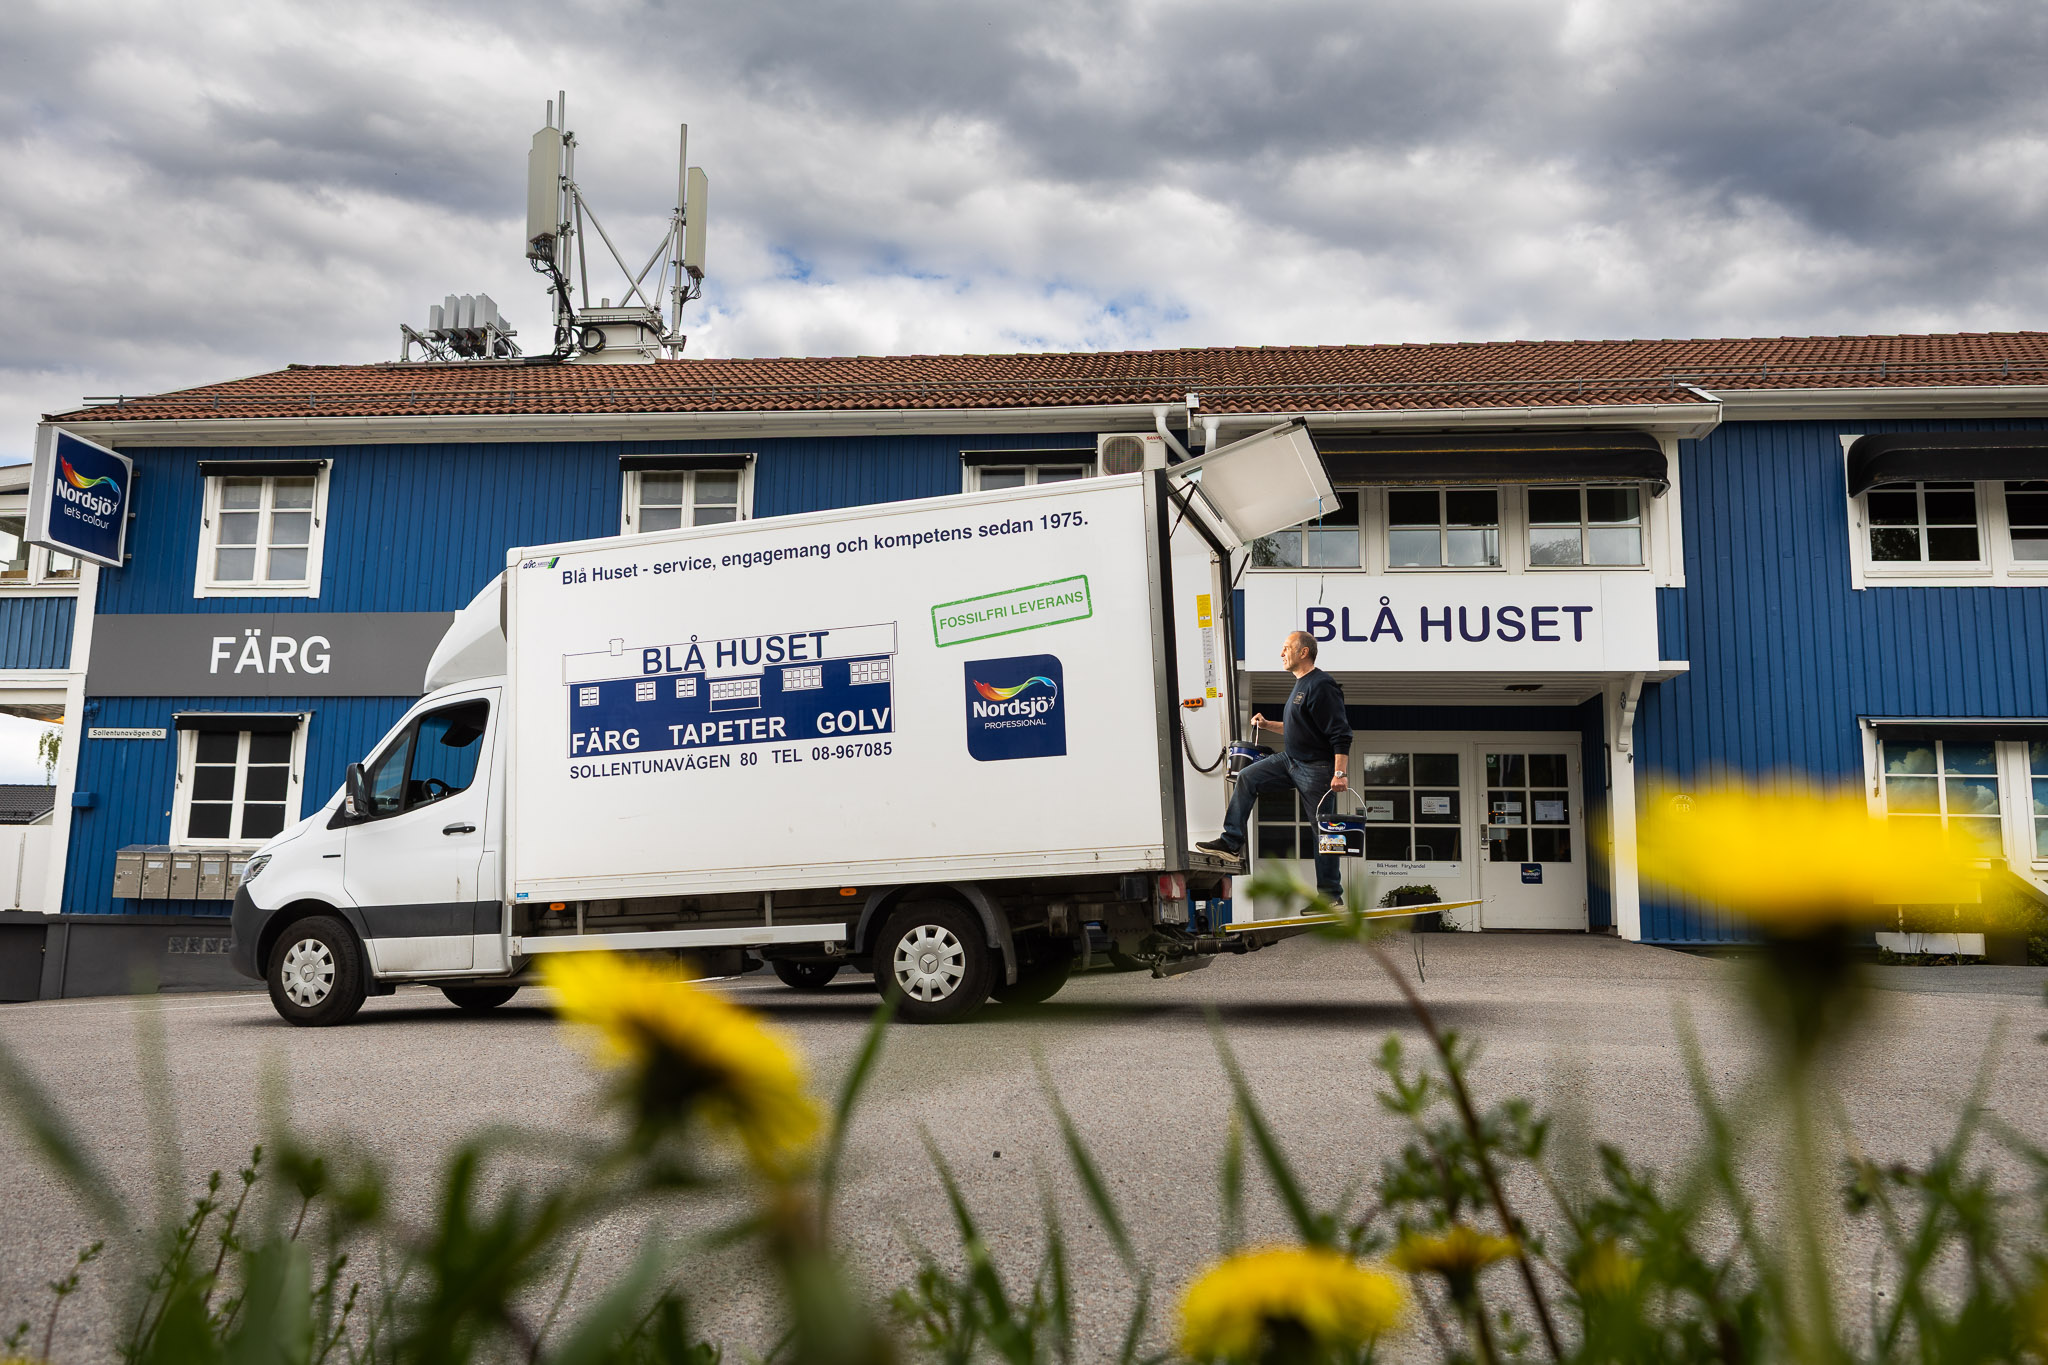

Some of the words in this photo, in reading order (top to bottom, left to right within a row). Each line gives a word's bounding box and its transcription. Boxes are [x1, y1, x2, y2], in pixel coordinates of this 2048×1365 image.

[56, 478, 112, 516] Nordsjö
[64, 503, 81, 520] let's
[82, 514, 110, 530] colour
[562, 567, 587, 585] Blå
[592, 563, 638, 582] Huset
[653, 557, 716, 576] service,
[721, 543, 831, 569] engagemang
[836, 536, 868, 553] och
[874, 527, 973, 550] kompetens
[978, 518, 1034, 538] sedan
[1040, 510, 1089, 530] 1975.
[939, 606, 1008, 630] FOSSILFRI
[1010, 591, 1084, 616] LEVERANS
[1306, 595, 1404, 643] BLÅ
[1420, 605, 1594, 643] HUSET
[209, 628, 332, 675] FÄRG
[643, 634, 706, 675] BLÅ
[716, 631, 830, 669] HUSET
[973, 696, 1049, 718] Nordsjö
[984, 718, 1047, 730] PROFESSIONAL
[92, 729, 150, 738] Sollentunavägen
[151, 729, 162, 737] 80
[572, 726, 641, 754] FÄRG
[668, 716, 787, 746] TAPETER
[816, 707, 891, 735] GOLV
[569, 754, 730, 780] SOLLENTUNAVÄGEN
[740, 752, 758, 767] 80
[772, 749, 803, 764] TEL
[811, 741, 893, 761] 08-967085
